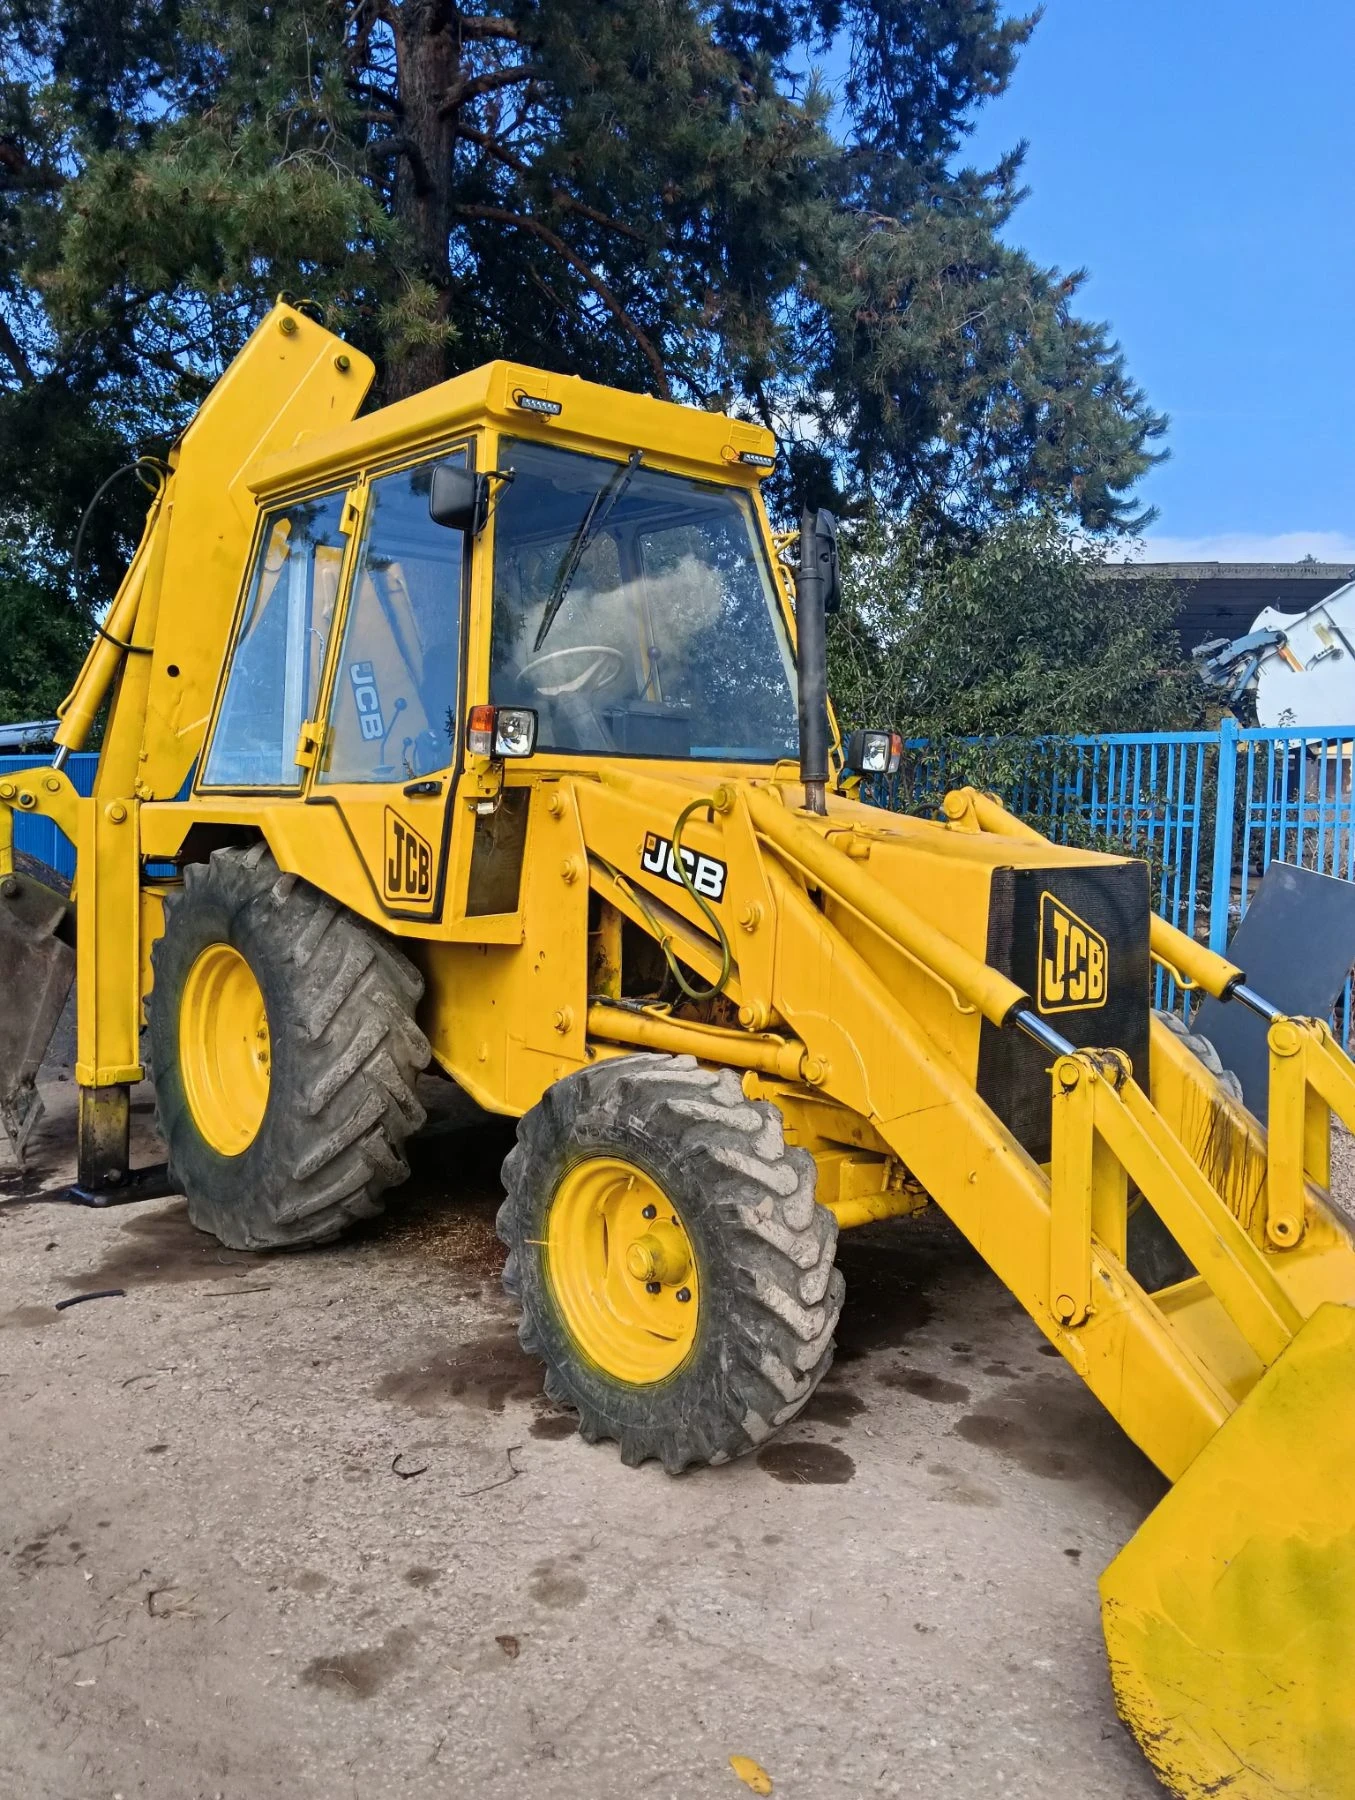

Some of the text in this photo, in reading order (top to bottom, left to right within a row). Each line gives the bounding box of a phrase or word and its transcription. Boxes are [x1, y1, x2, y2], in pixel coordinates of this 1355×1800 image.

[350, 664, 383, 740] JCB
[389, 820, 429, 894] JCB
[644, 841, 724, 898] JCB
[1044, 910, 1103, 1001] JCB
